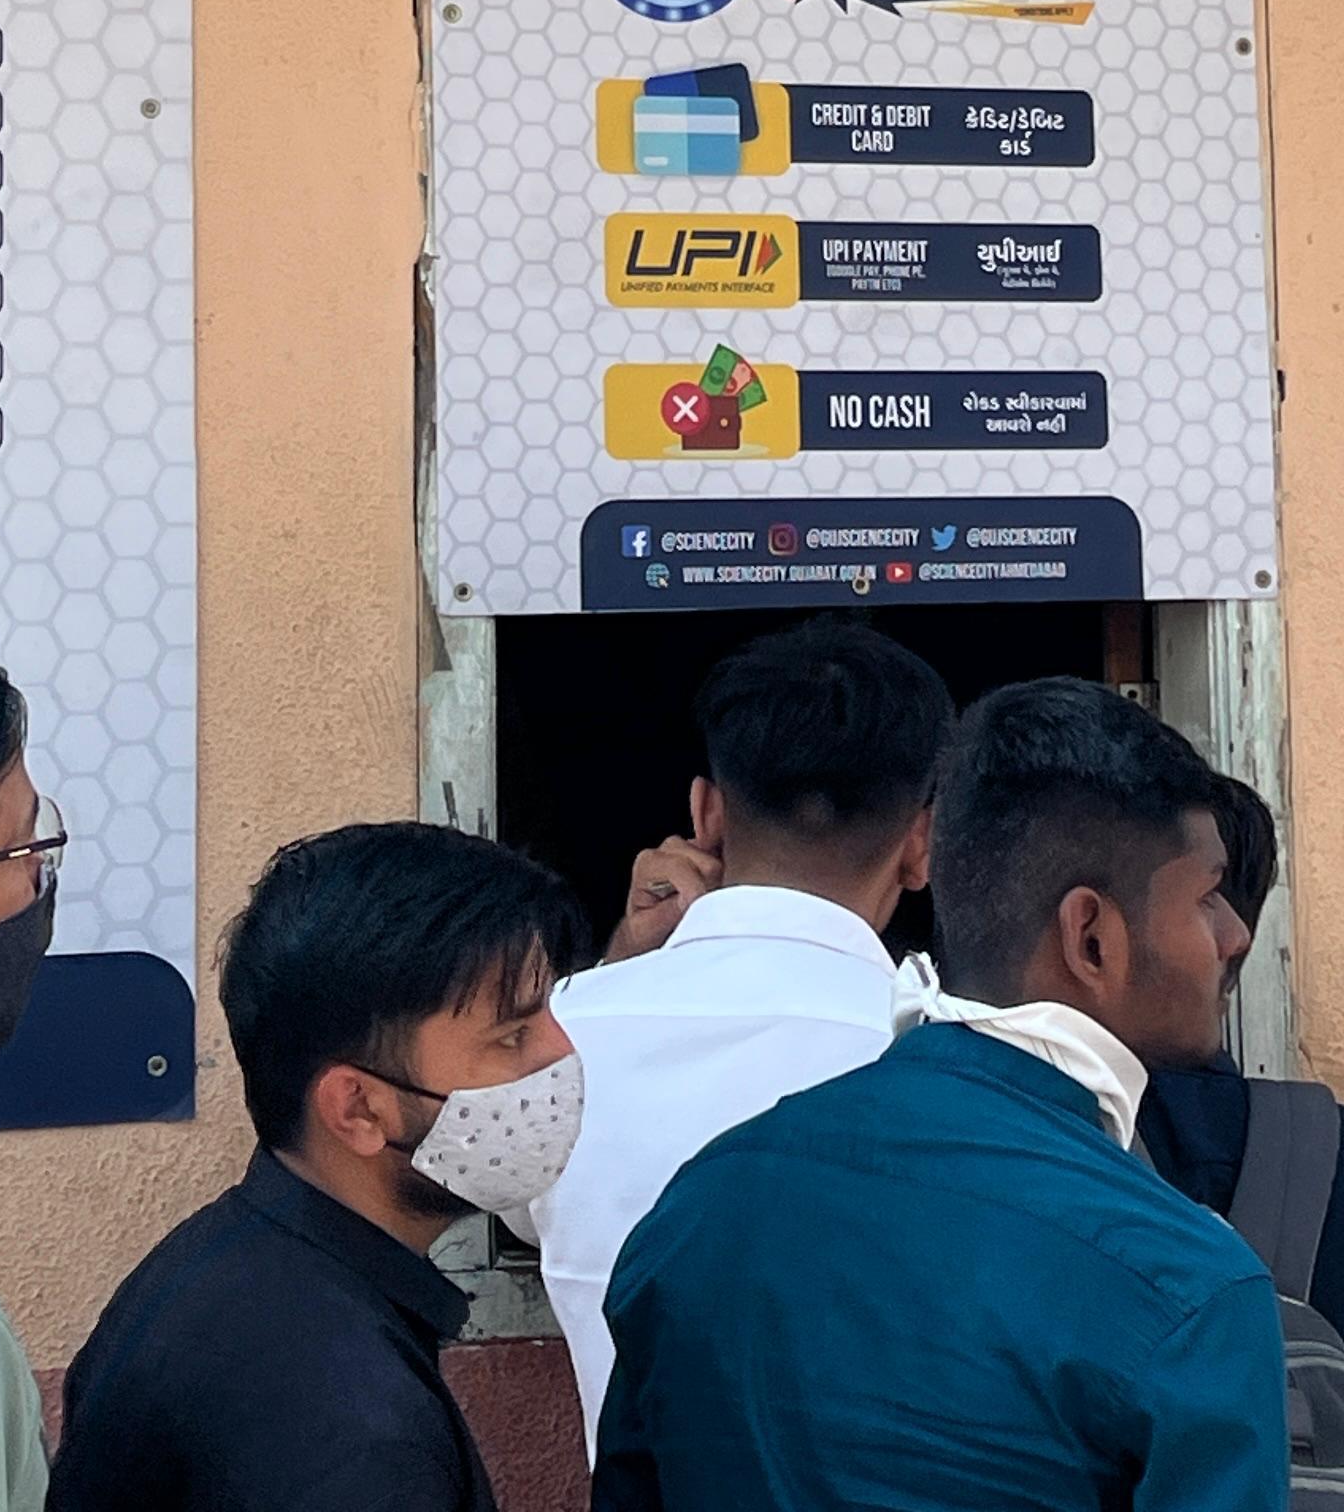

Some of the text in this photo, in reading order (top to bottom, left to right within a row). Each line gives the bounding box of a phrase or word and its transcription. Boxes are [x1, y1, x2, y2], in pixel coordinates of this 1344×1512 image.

[812, 103, 931, 128] CREDIT & DEBIT
[852, 130, 894, 152] CARD
[626, 230, 757, 276] UPI
[823, 240, 928, 263] UPI PAYMENT
[977, 237, 1062, 272] યુપીઆઈ
[621, 282, 775, 293] UNIFIED PAYMENTS INTERFACE
[830, 396, 931, 428] NO CASH
[963, 392, 1000, 411] રોકડ
[661, 531, 755, 552] @SCIENCECITY
